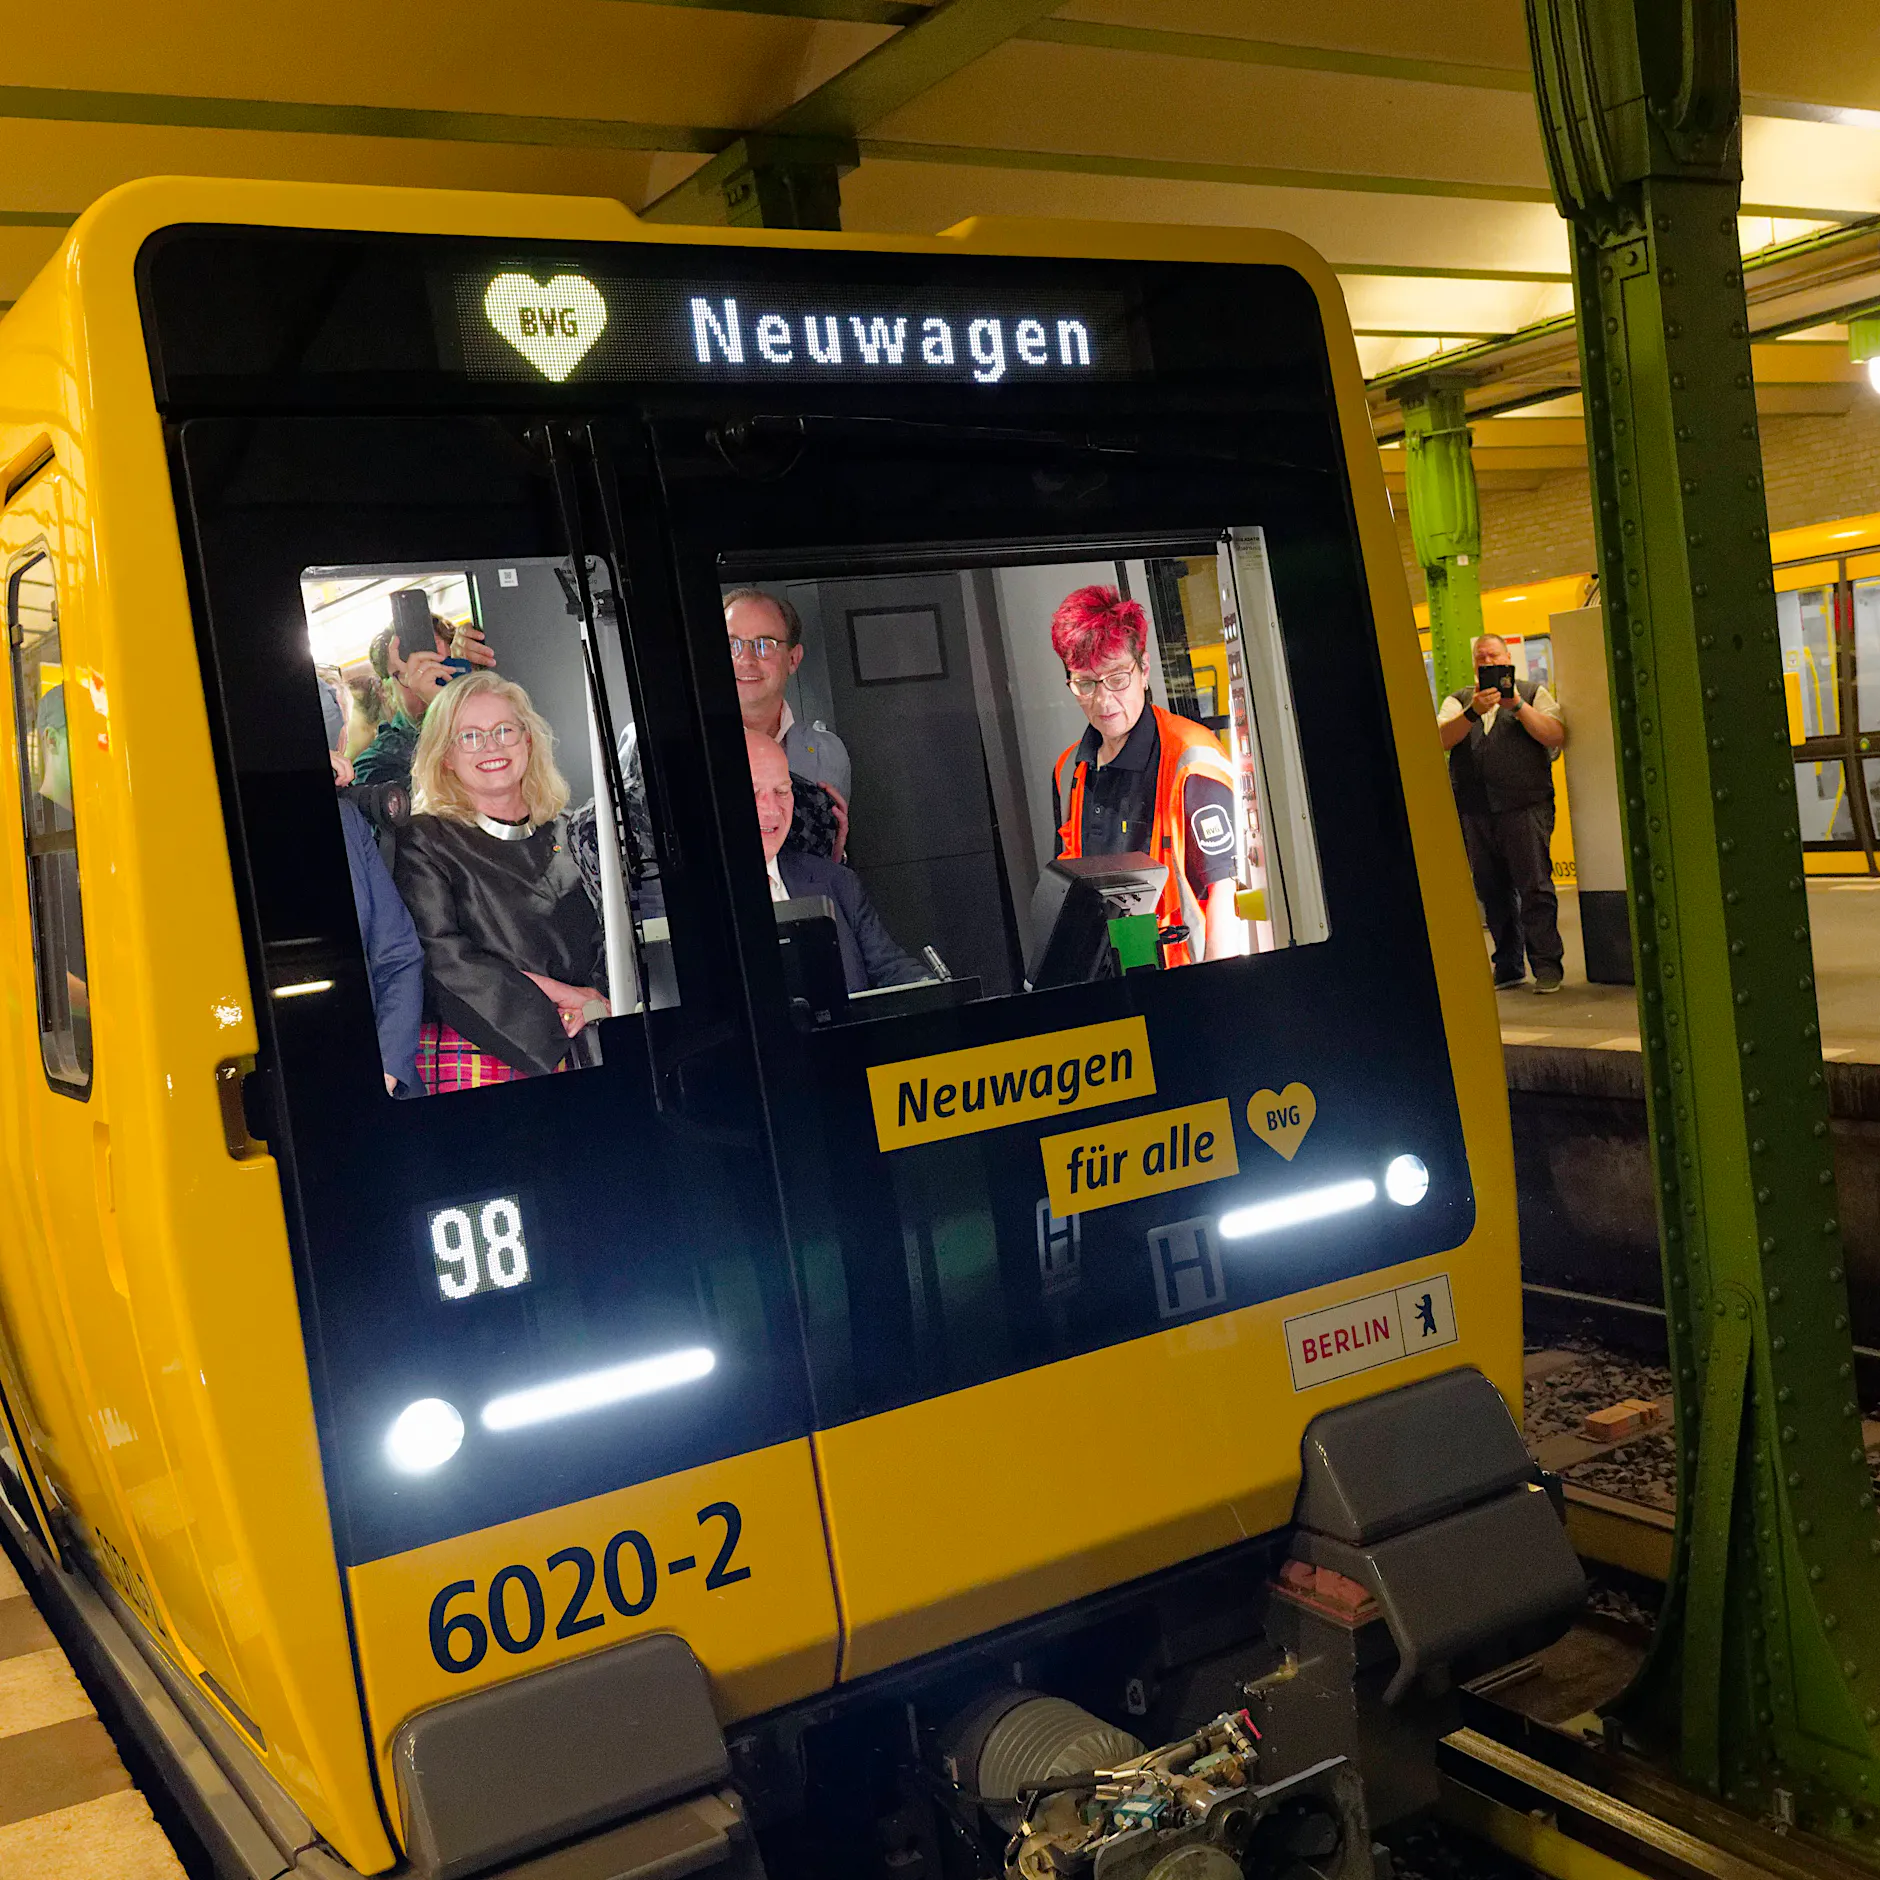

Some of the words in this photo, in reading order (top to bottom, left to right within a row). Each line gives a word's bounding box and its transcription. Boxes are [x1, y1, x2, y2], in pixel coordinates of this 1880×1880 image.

[518, 306, 578, 337] BVG
[691, 297, 1091, 384] Neuwagen
[897, 1047, 1133, 1127] Neuwagen
[1266, 1104, 1301, 1132] BVG
[1066, 1144, 1128, 1194] für
[1142, 1123, 1215, 1175] alle
[431, 1198, 528, 1299] 98
[1302, 1315, 1391, 1365] BERLIN
[428, 1501, 752, 1674] 6020-2
